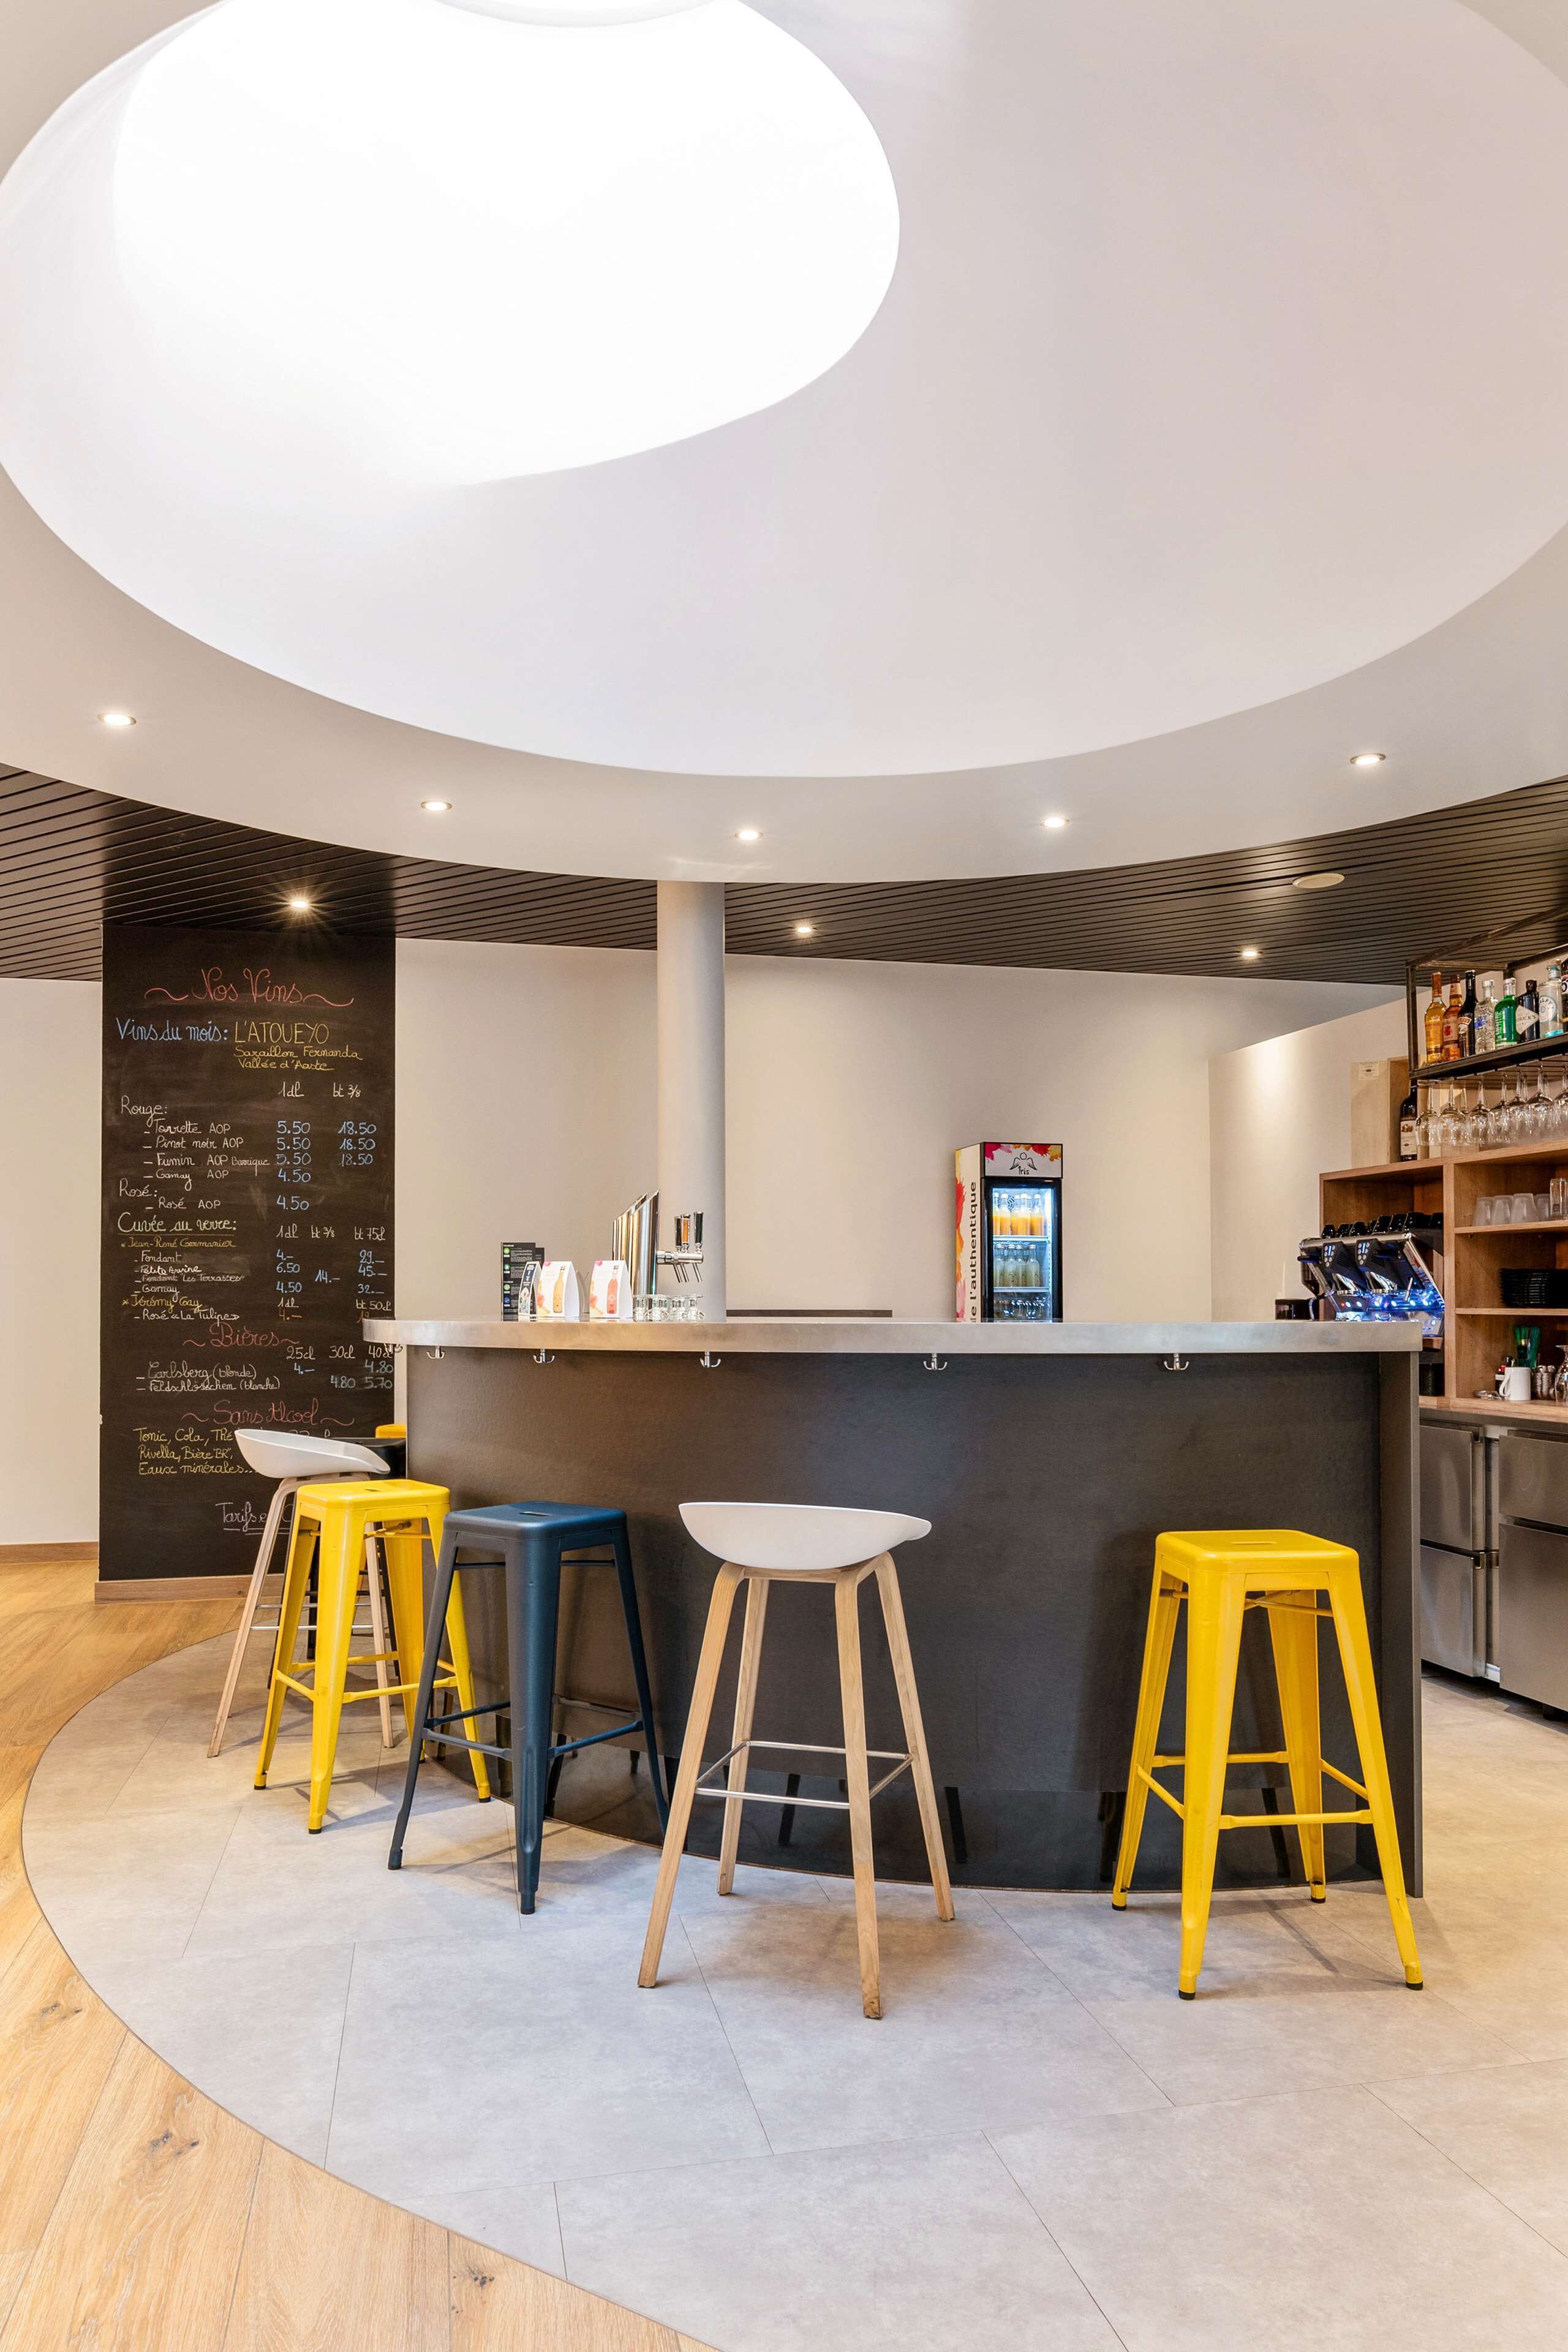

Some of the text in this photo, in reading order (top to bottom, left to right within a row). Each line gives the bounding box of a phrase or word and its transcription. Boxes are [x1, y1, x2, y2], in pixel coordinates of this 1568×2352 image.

[191, 967, 304, 1003] Nos Vins
[116, 1017, 157, 1041] Vins
[158, 1020, 183, 1041] du
[238, 1058, 277, 1069] Vallée
[347, 1084, 361, 1098] 3/8
[209, 1123, 231, 1134] AOP
[277, 1120, 311, 1134] 5.50
[337, 1121, 377, 1135] 18.50
[156, 1135, 376, 1151] Pinot noir AOP 5.50 18.50
[157, 1153, 195, 1166] Fumin
[206, 1154, 228, 1166] AOP
[276, 1153, 312, 1166] 5.50
[340, 1153, 374, 1166] 18.50
[156, 1169, 312, 1191] Gamay AOP 4.50
[158, 1195, 310, 1211] Rosé AOP 4.50
[118, 1212, 167, 1232] Cuvée
[323, 1226, 336, 1238] 3/8
[276, 1262, 301, 1273] 6.50
[141, 1284, 180, 1303] Gamay
[276, 1281, 303, 1294] 4.50
[179, 1296, 203, 1314] Gay
[143, 1308, 169, 1321] Rosé
[209, 1322, 281, 1348] Bières
[148, 1360, 212, 1389] Carlsberg
[364, 1359, 394, 1374] 4.80
[330, 1375, 356, 1389] 4.80
[364, 1376, 393, 1389] 5.70
[213, 1399, 263, 1425] Sans
[181, 1446, 214, 1460] Bière
[138, 1461, 178, 1476] Eaux
[216, 1501, 257, 1532] Tarifs
